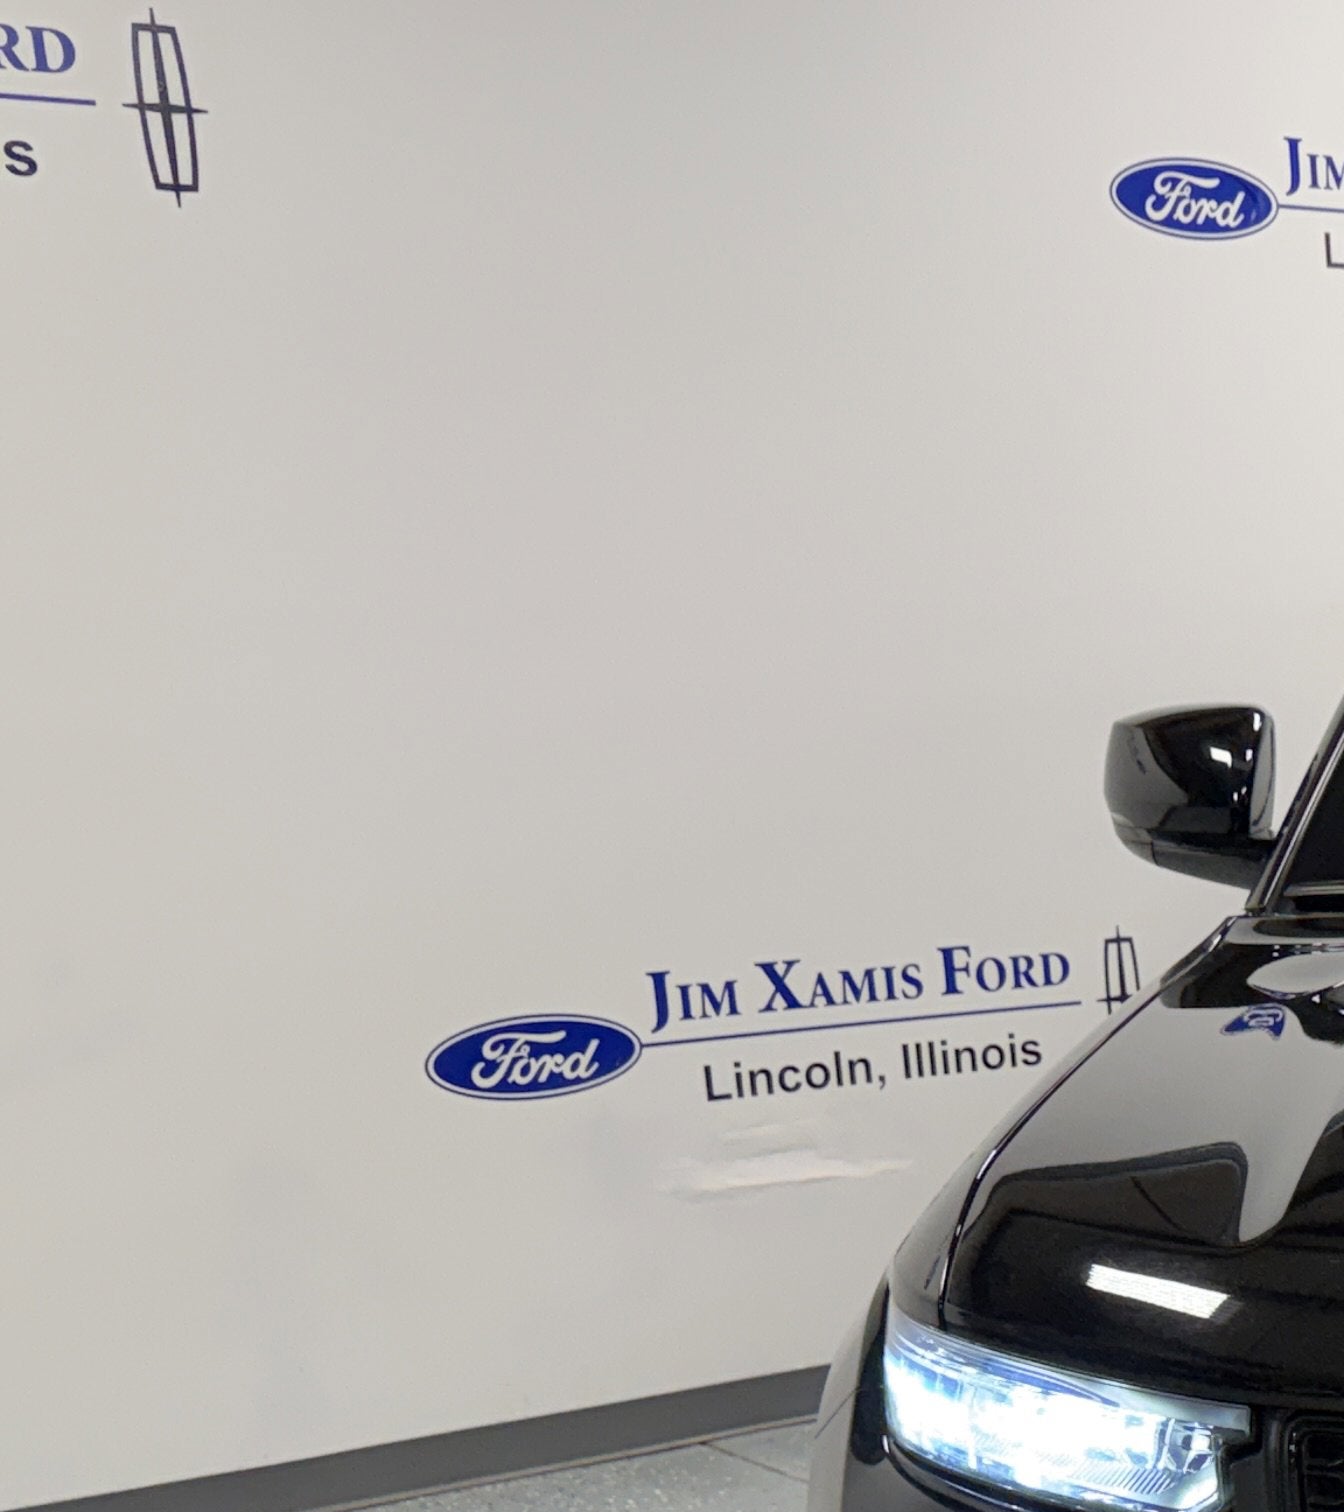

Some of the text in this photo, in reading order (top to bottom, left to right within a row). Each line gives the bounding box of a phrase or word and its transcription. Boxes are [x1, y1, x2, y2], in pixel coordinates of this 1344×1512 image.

[1145, 169, 1246, 231] Ford
[646, 945, 1071, 1033] JIM XAMIS FORD
[470, 1029, 600, 1090] Ford
[703, 1033, 1043, 1102] Lincoln, Illinois
